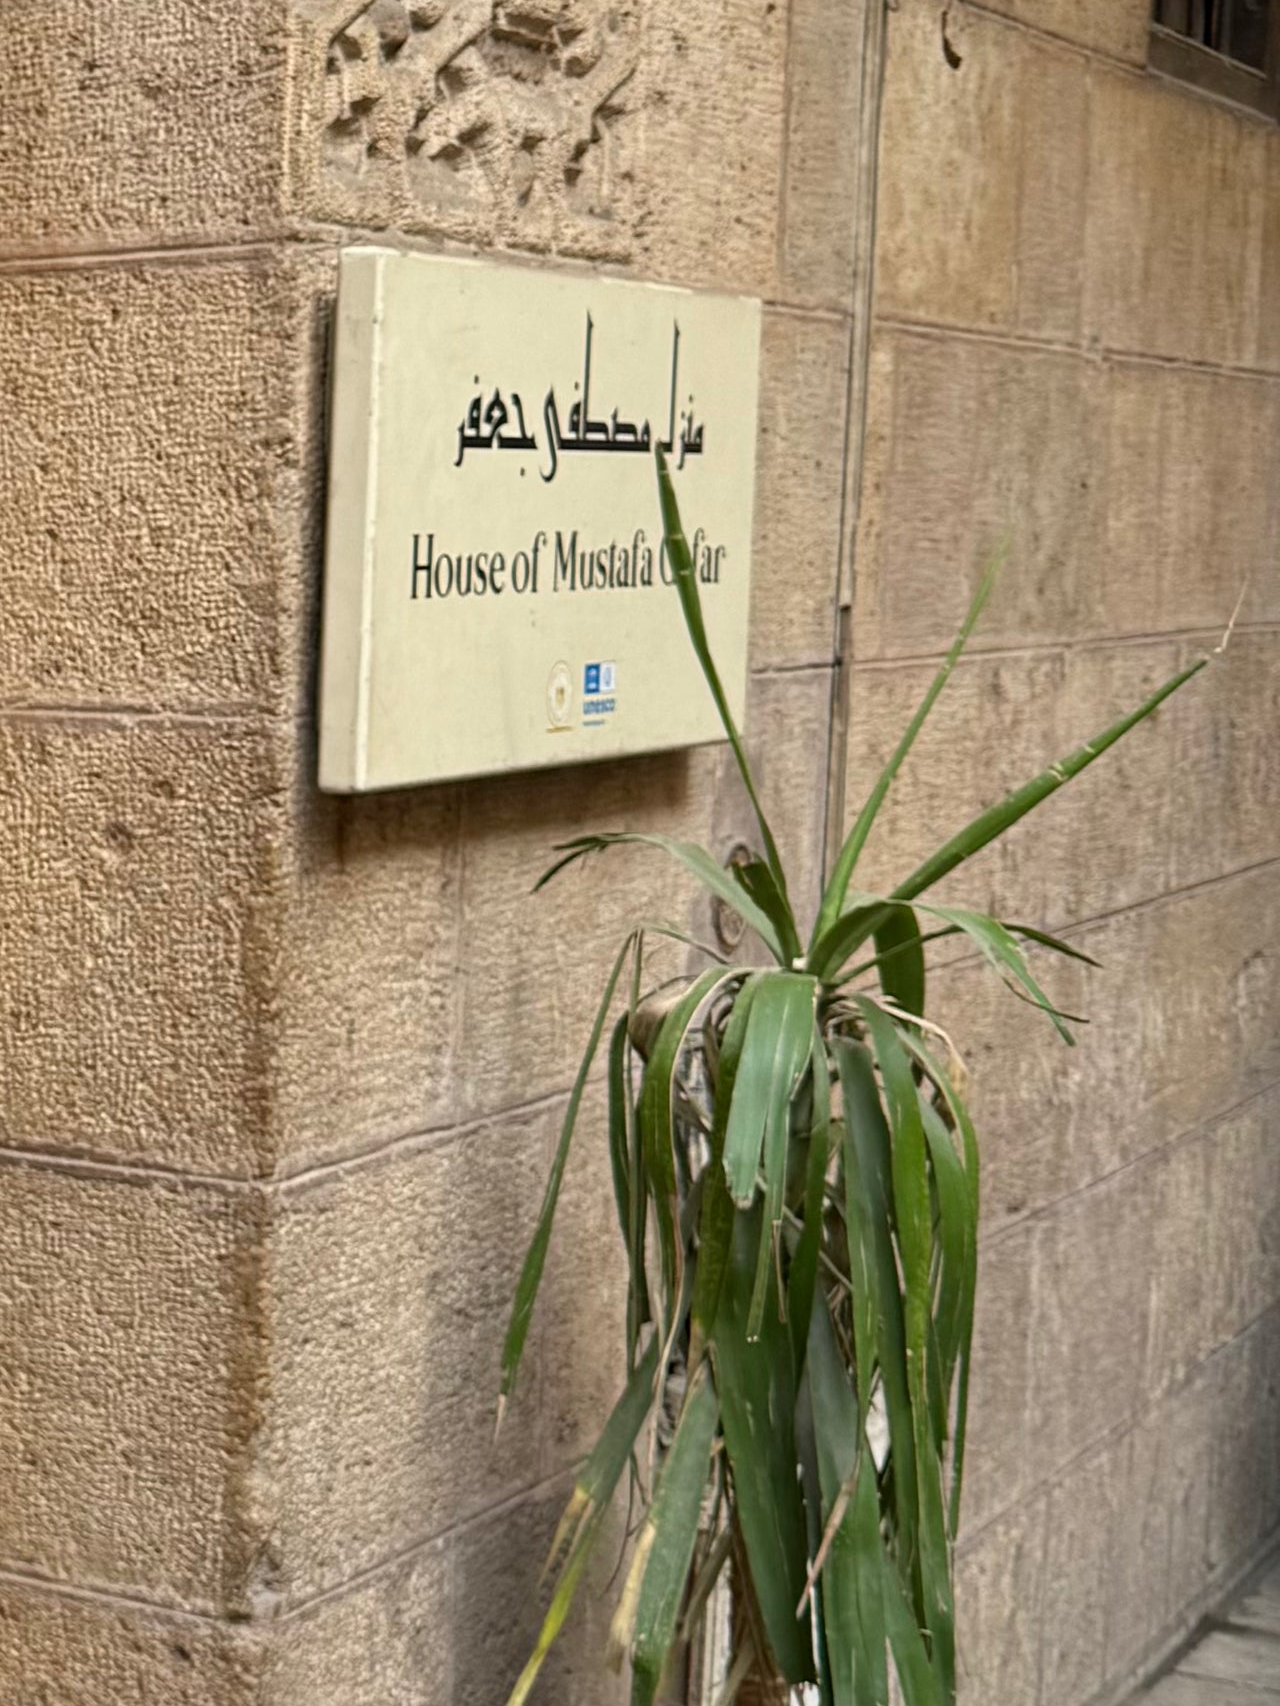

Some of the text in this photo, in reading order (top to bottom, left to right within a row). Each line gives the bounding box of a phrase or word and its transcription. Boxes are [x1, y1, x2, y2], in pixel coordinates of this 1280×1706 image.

[453, 373, 539, 477] جعفر
[653, 318, 705, 471] منزل
[410, 532, 506, 600] House
[511, 530, 548, 594] of
[552, 528, 653, 593] Mustafa
